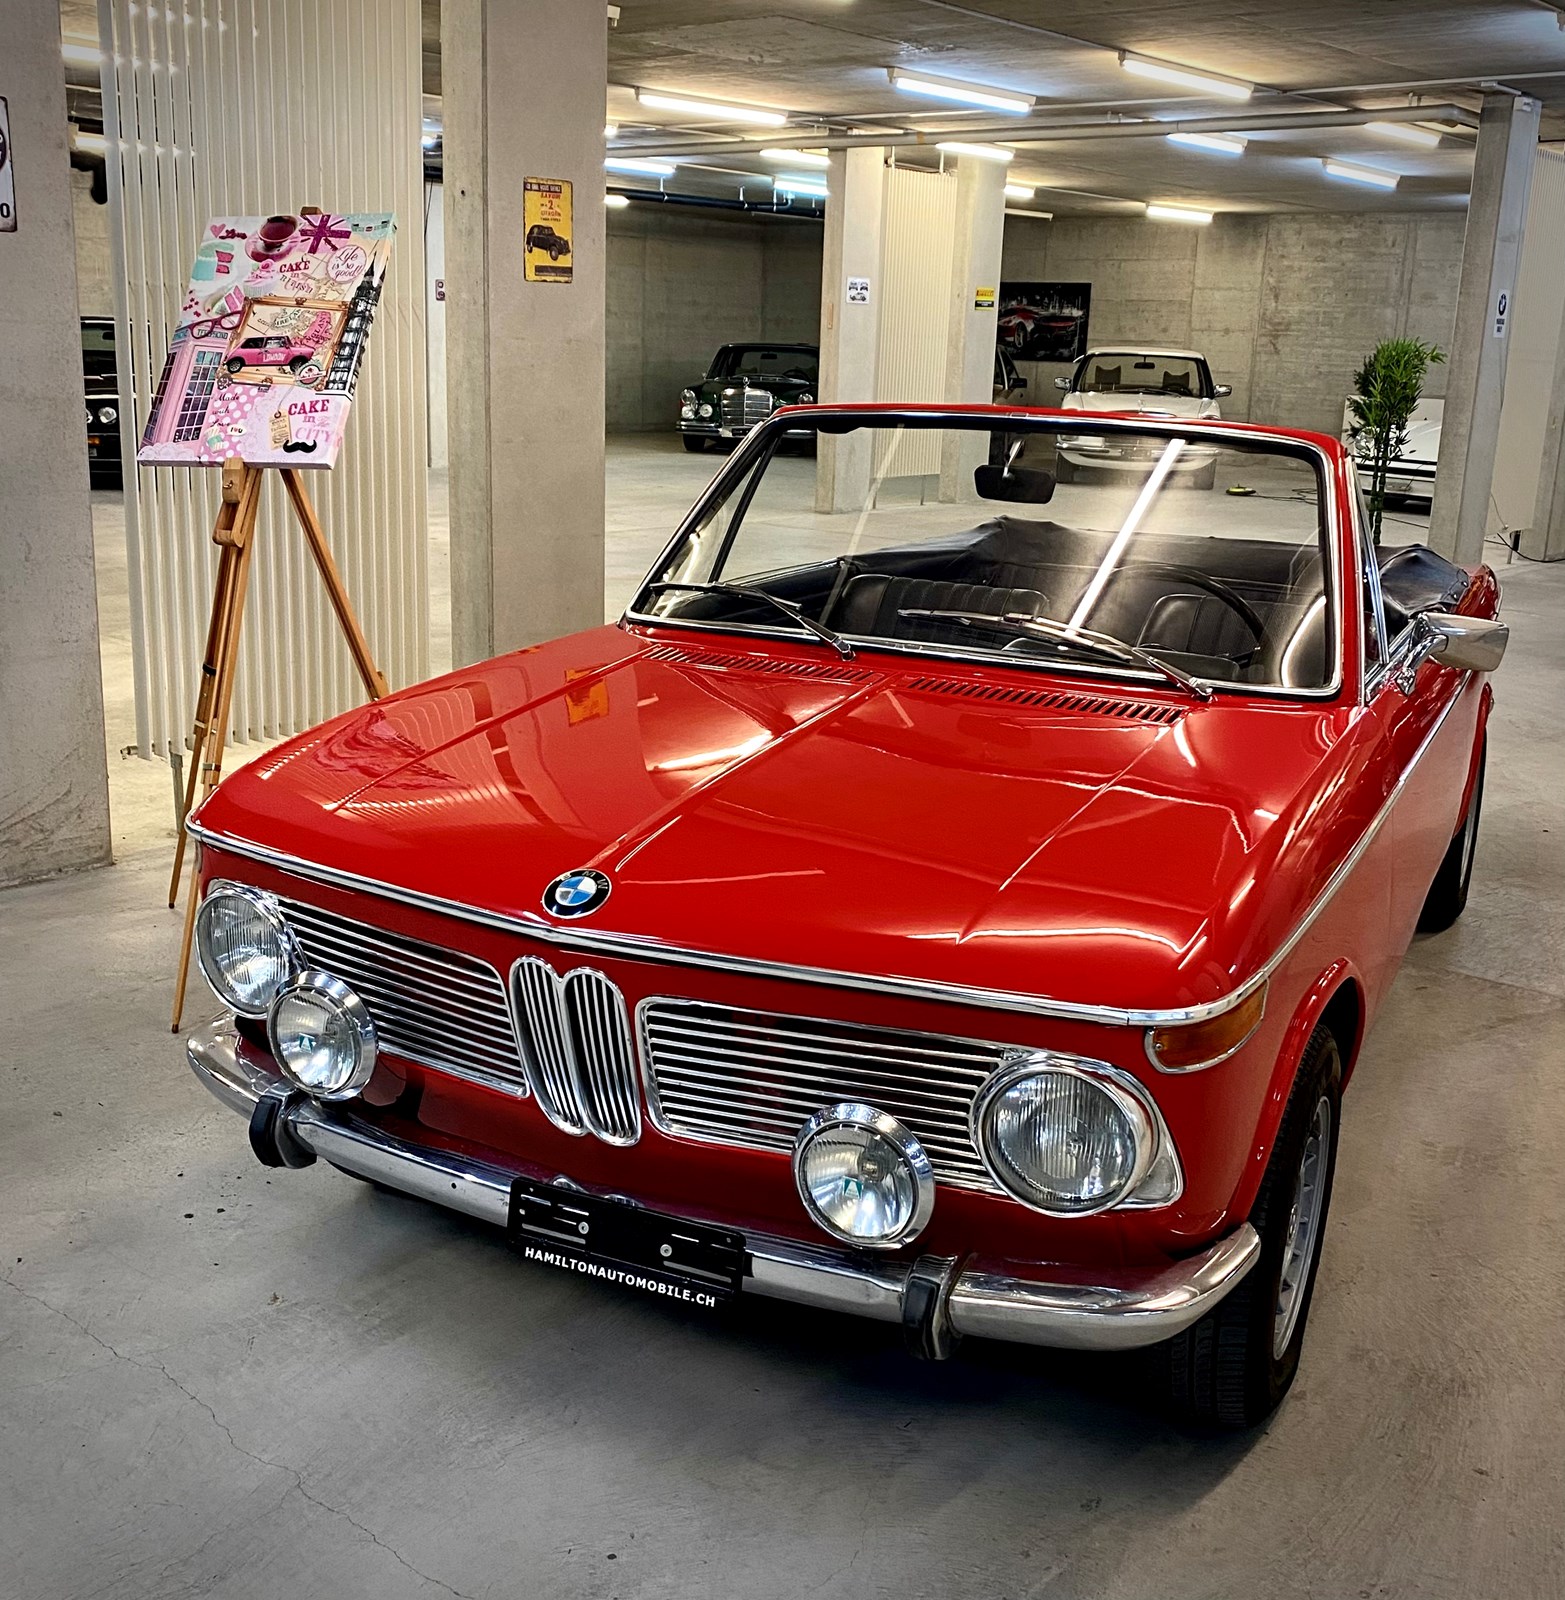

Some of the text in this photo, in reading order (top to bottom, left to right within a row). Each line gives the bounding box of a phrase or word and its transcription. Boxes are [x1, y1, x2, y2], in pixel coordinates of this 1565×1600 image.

[279, 260, 310, 273] CAKE
[288, 399, 329, 416] CAKE
[303, 416, 315, 424] in
[295, 427, 331, 442] CITY
[525, 1247, 715, 1308] HAMILTONAUTOMOBILE.CH
